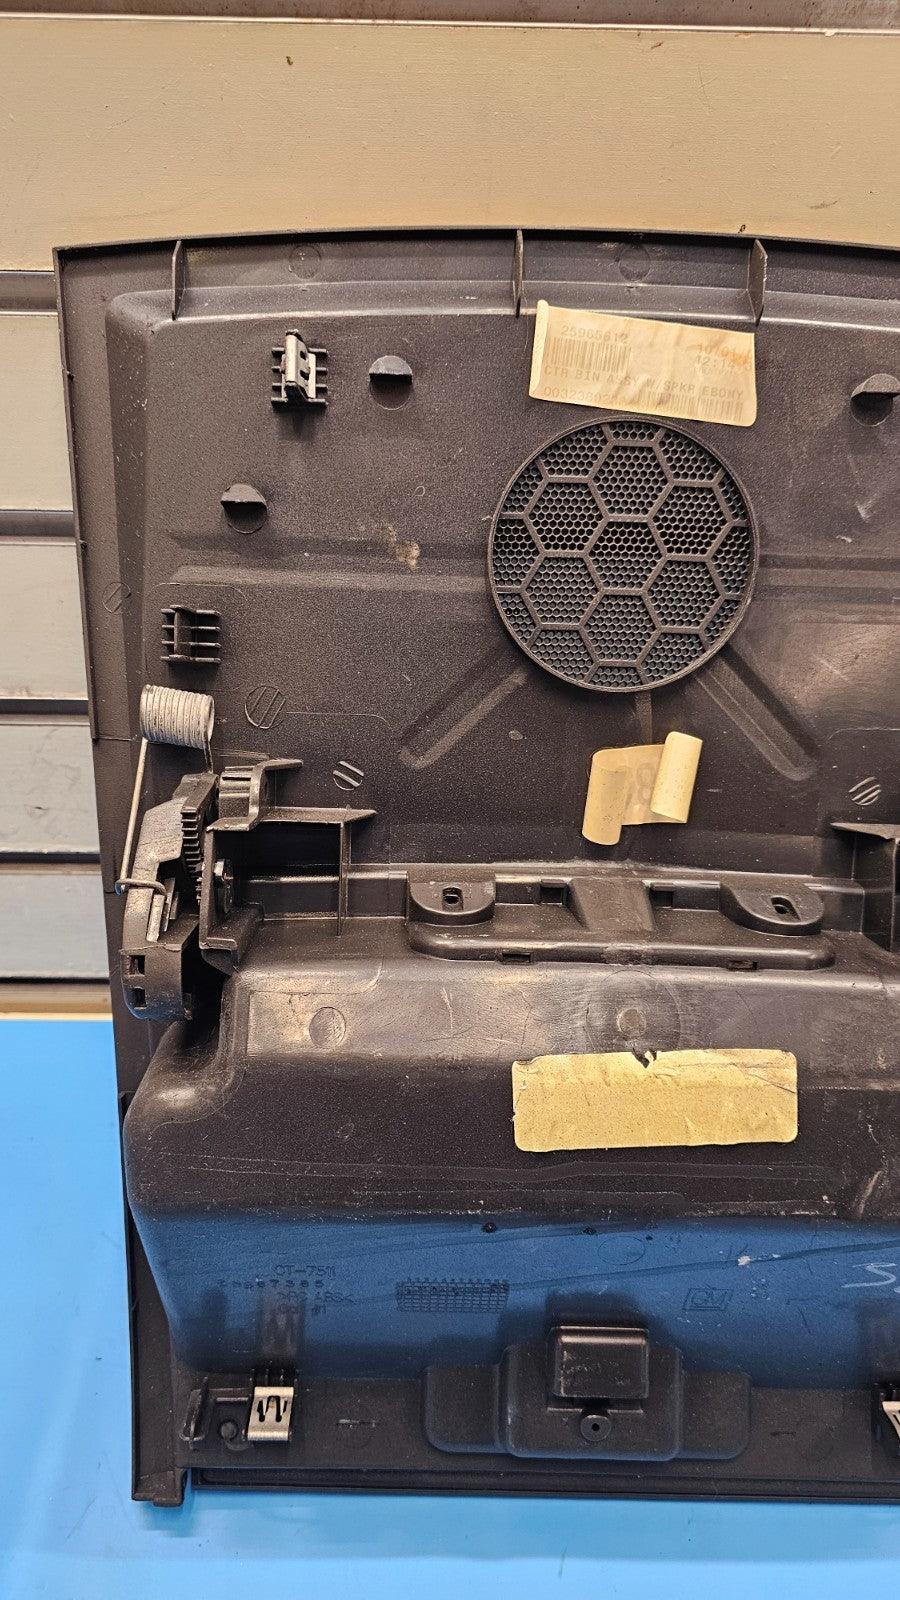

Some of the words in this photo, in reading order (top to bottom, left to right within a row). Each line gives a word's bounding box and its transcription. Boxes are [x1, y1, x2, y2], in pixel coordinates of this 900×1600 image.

[560, 325, 629, 343] 25965612
[544, 365, 569, 379] CTR
[575, 369, 601, 382] BIN
[702, 385, 744, 399] EBONY
